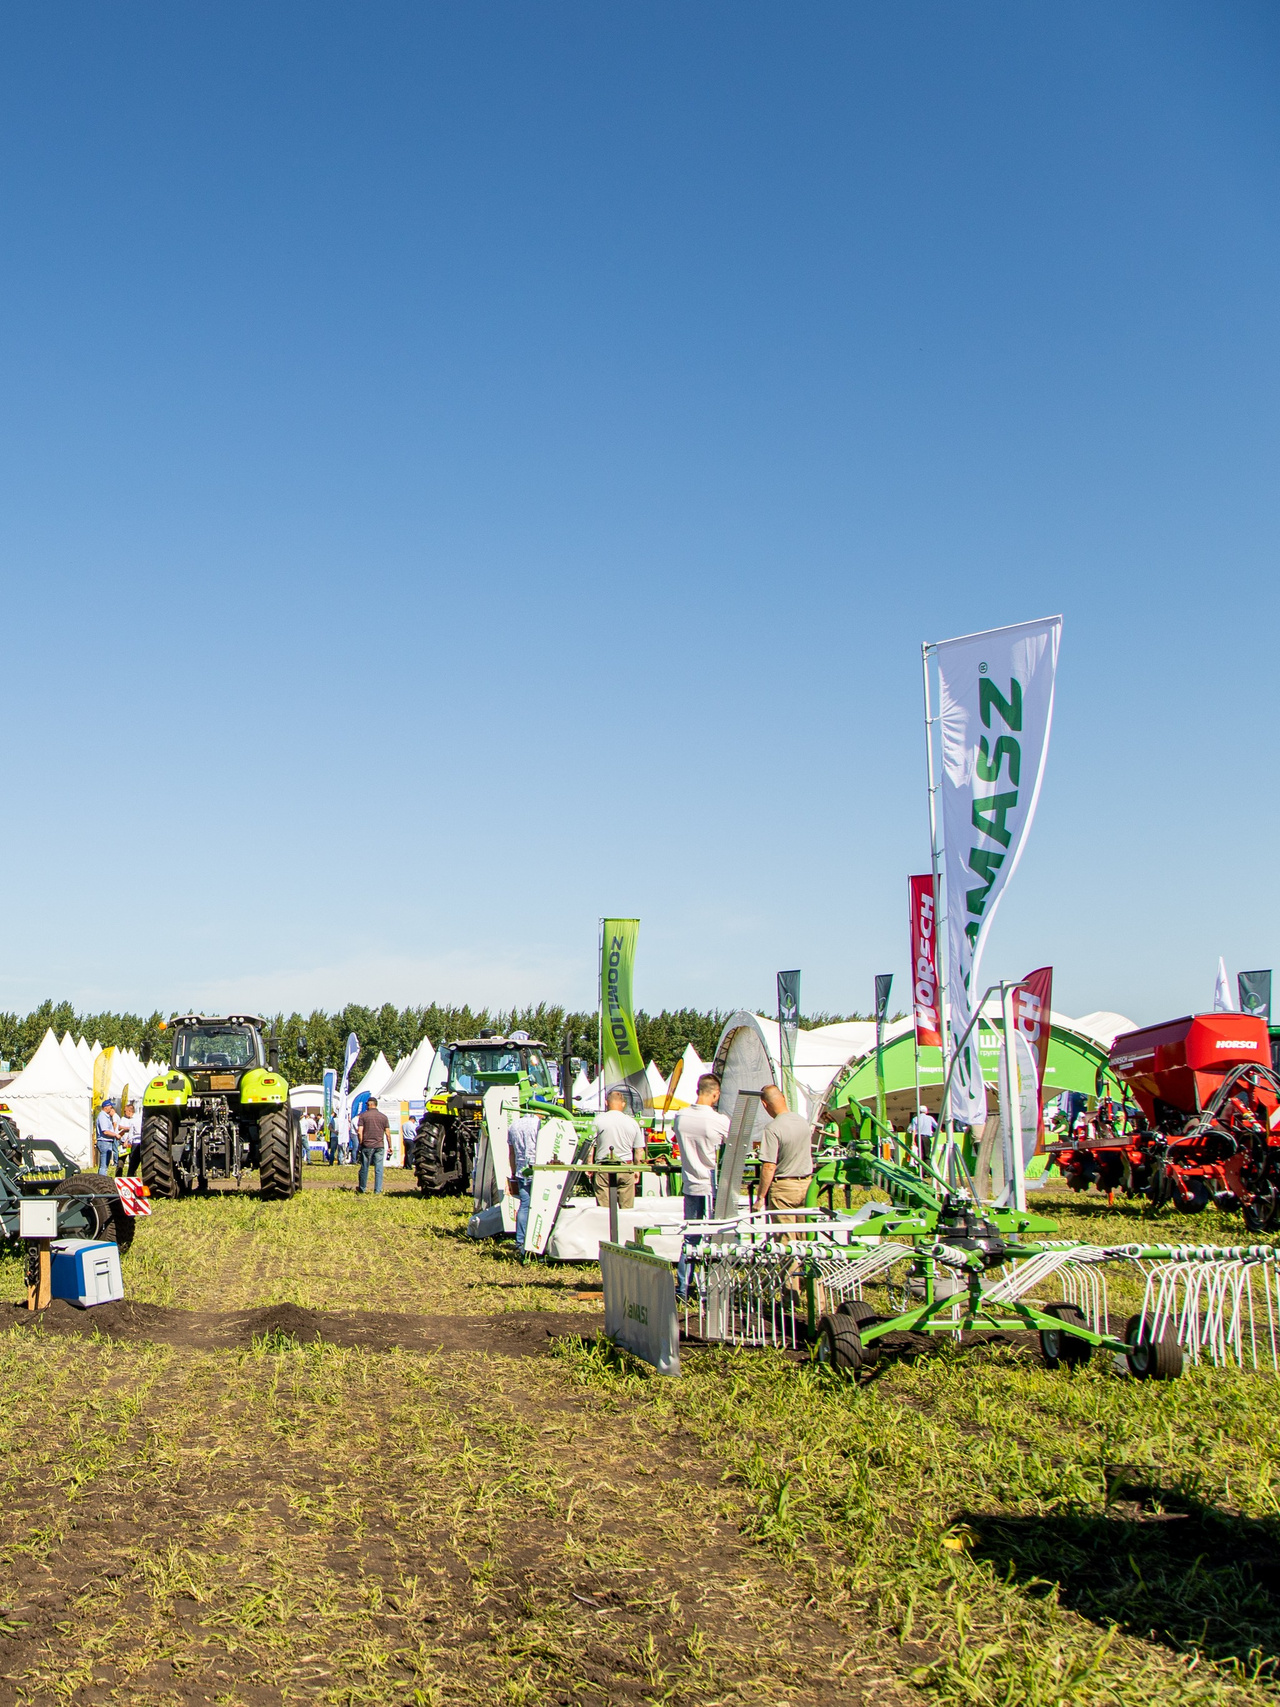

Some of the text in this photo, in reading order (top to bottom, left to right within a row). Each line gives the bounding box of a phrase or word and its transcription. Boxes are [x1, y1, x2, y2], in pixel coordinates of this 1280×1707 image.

[607, 936, 630, 1056] ZOOMLION
[915, 893, 936, 1032] HORSCH
[1215, 1041, 1258, 1049] HORSCH
[553, 1132, 564, 1155] SaM
